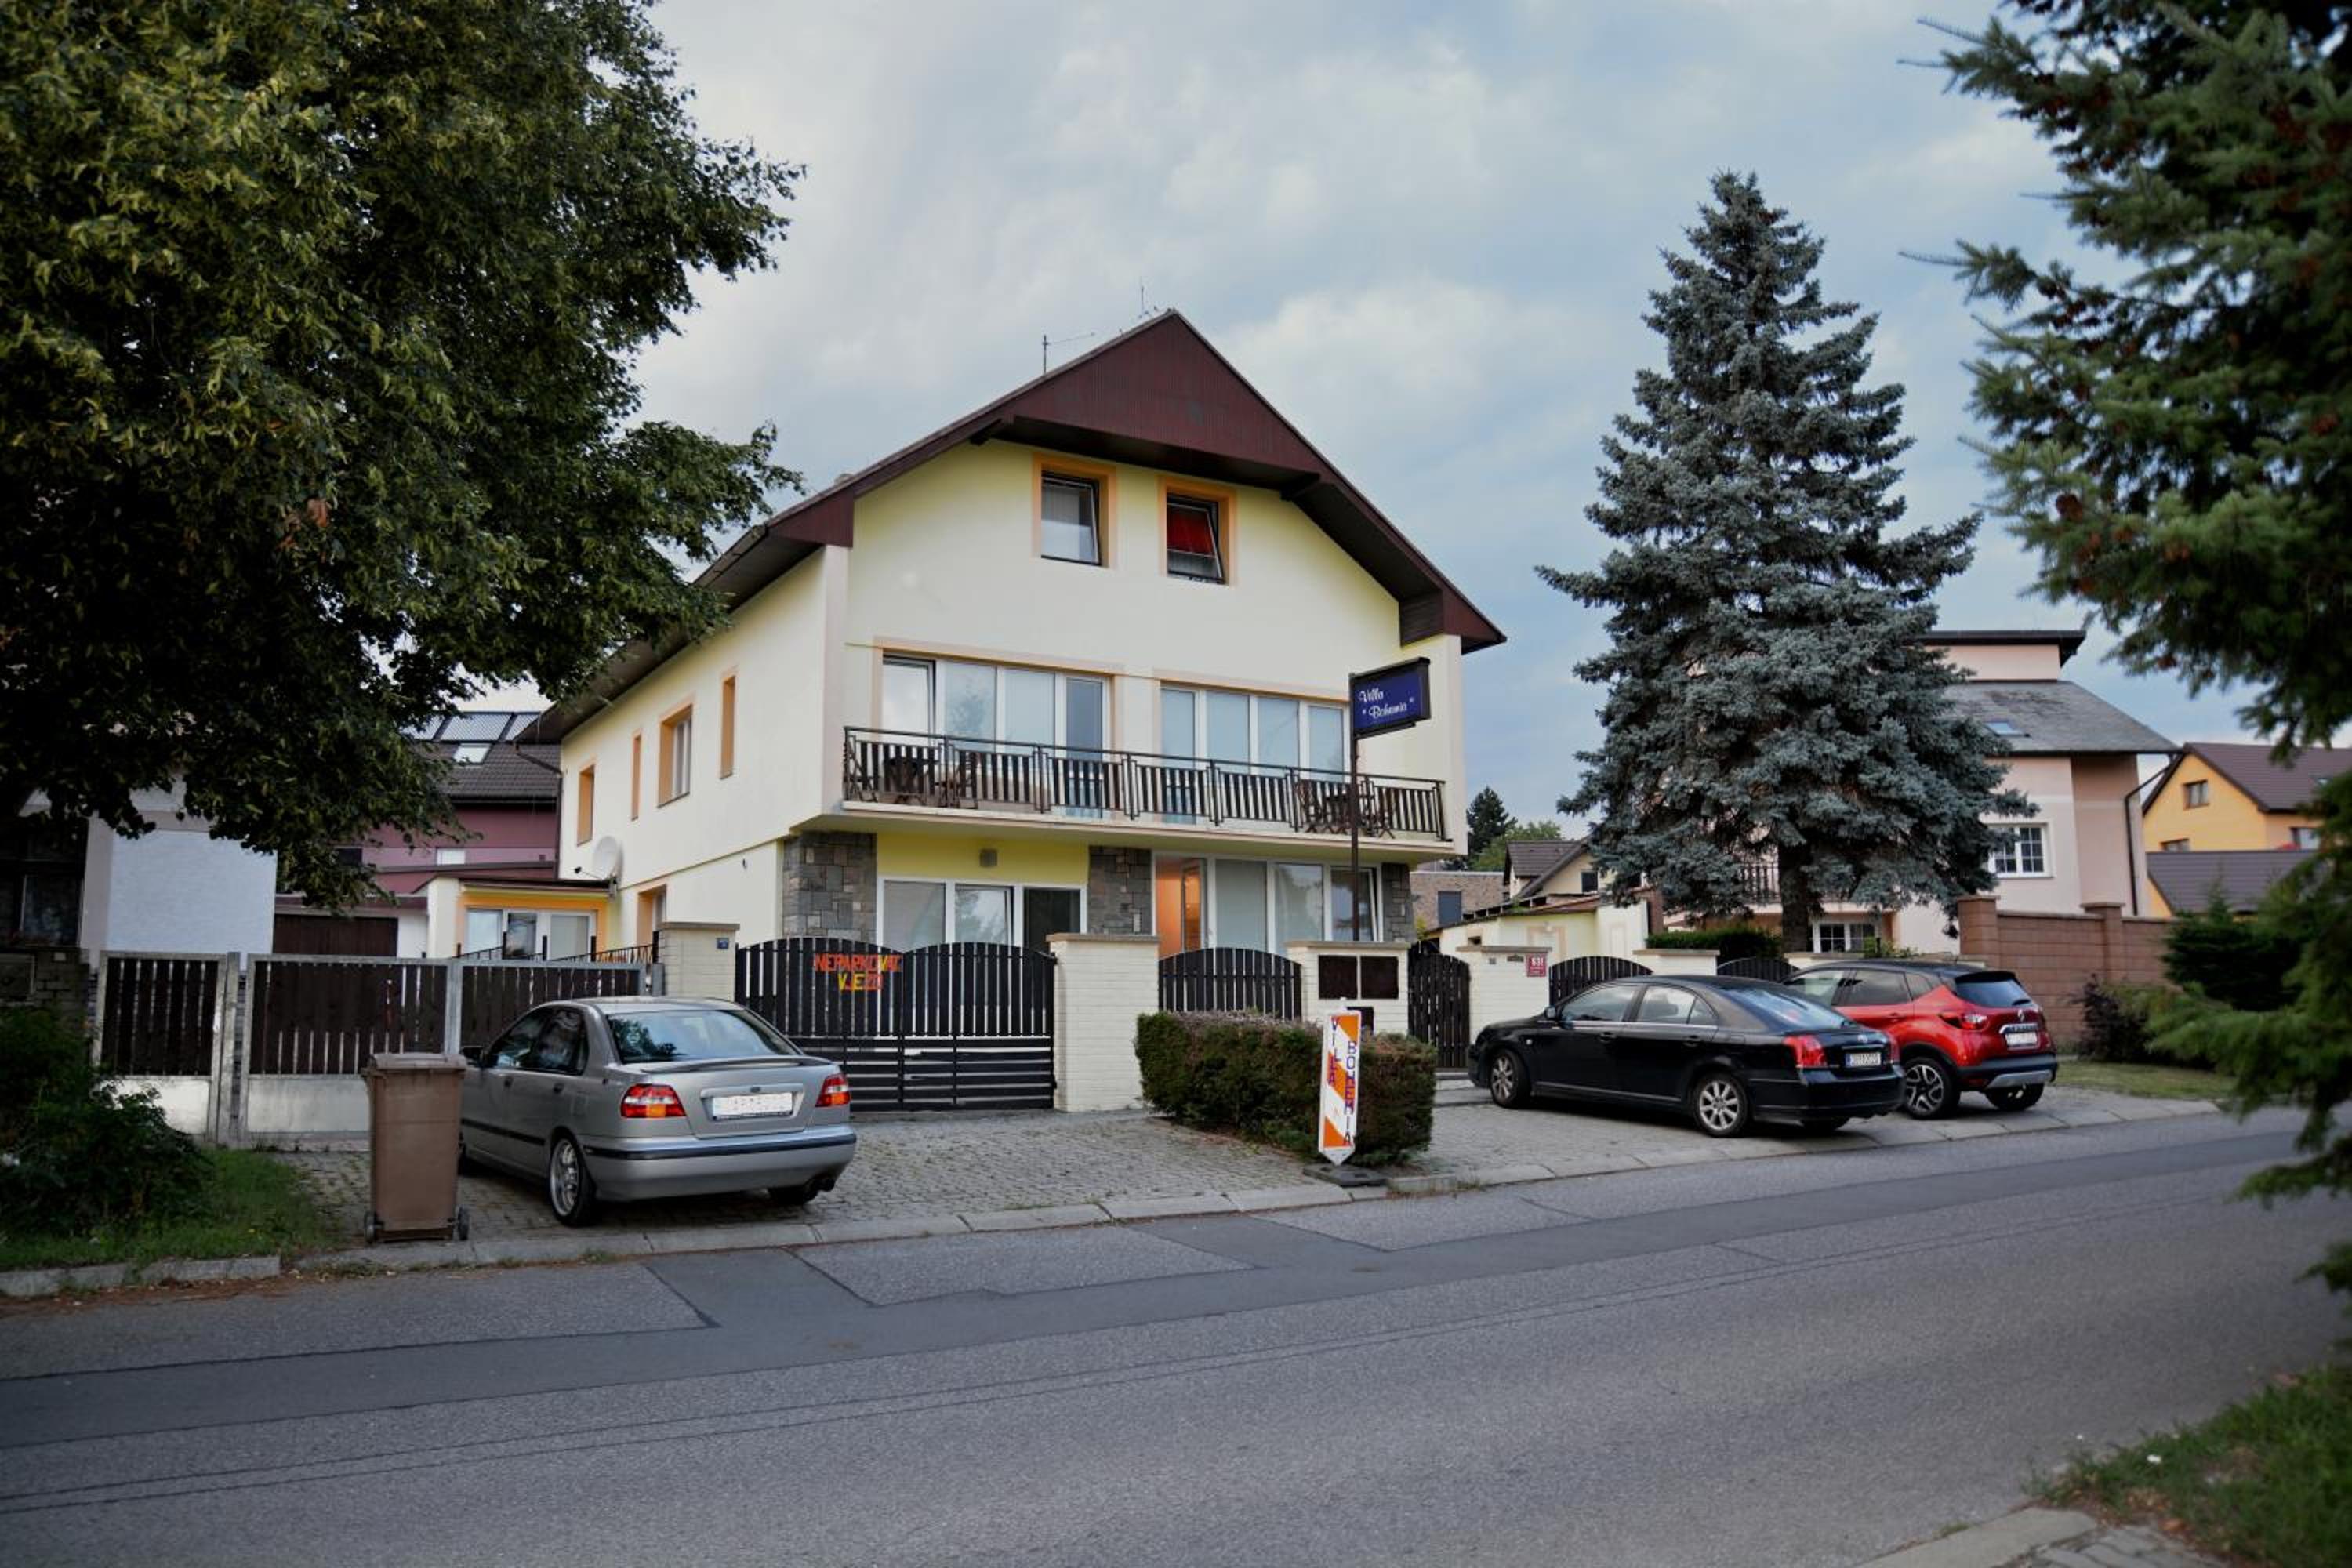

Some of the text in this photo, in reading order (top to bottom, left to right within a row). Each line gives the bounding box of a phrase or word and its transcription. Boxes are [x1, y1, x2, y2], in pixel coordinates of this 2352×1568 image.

[1358, 688, 1384, 702] Villa
[1327, 1016, 1342, 1087] VILLA
[1343, 1040, 1357, 1146] BOHEMIA
